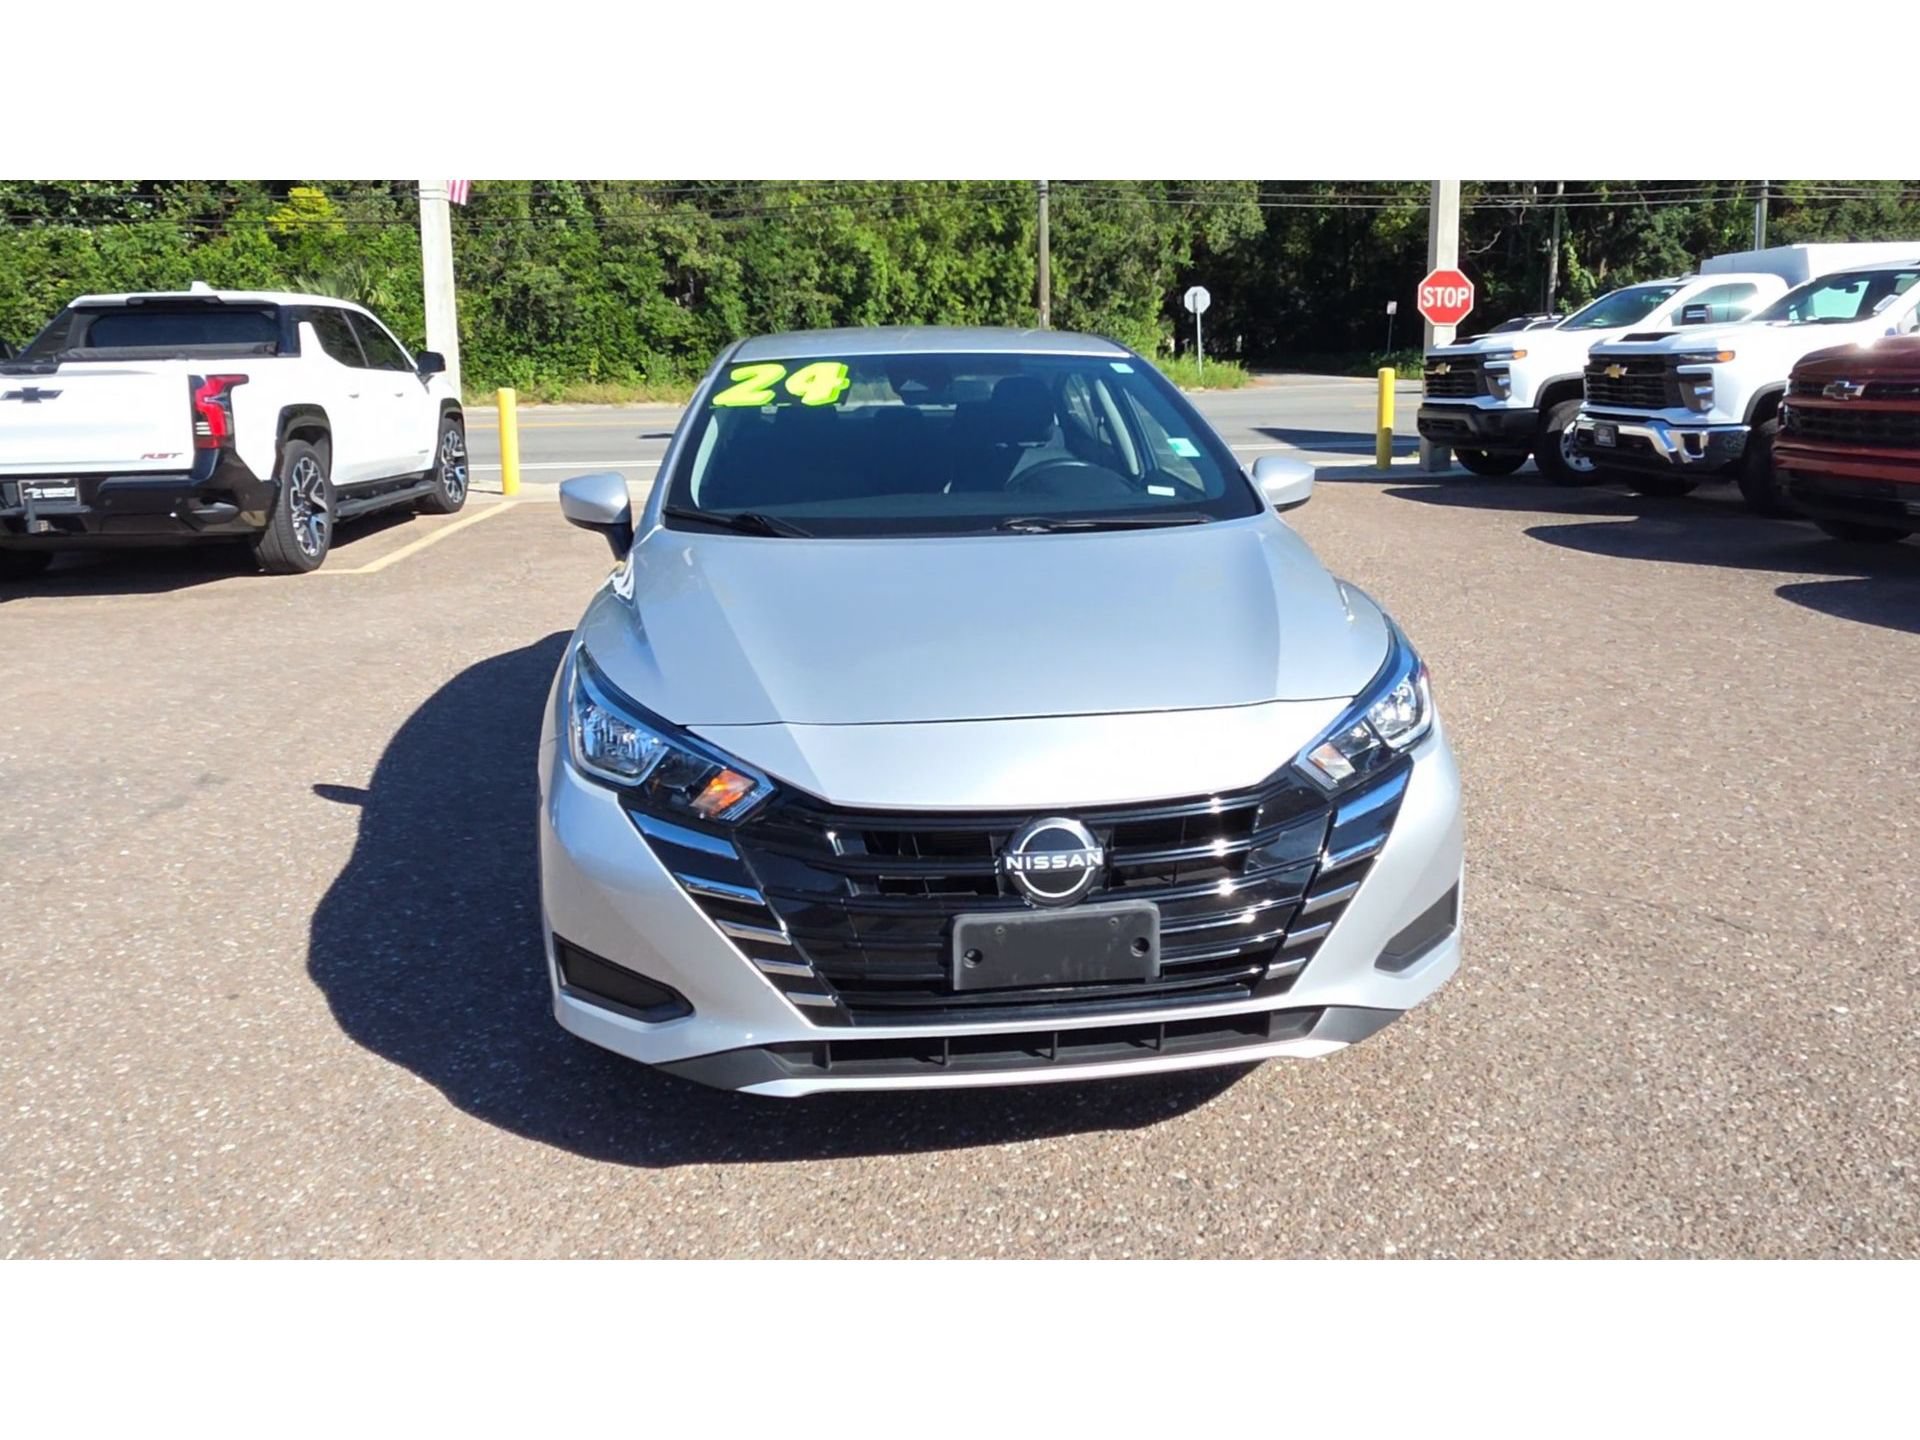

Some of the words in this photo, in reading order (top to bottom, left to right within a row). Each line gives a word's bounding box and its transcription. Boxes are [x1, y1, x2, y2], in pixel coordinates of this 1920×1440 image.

[1423, 286, 1469, 308] STOP
[712, 362, 850, 406] 24
[1006, 852, 1104, 870] NISSAN
